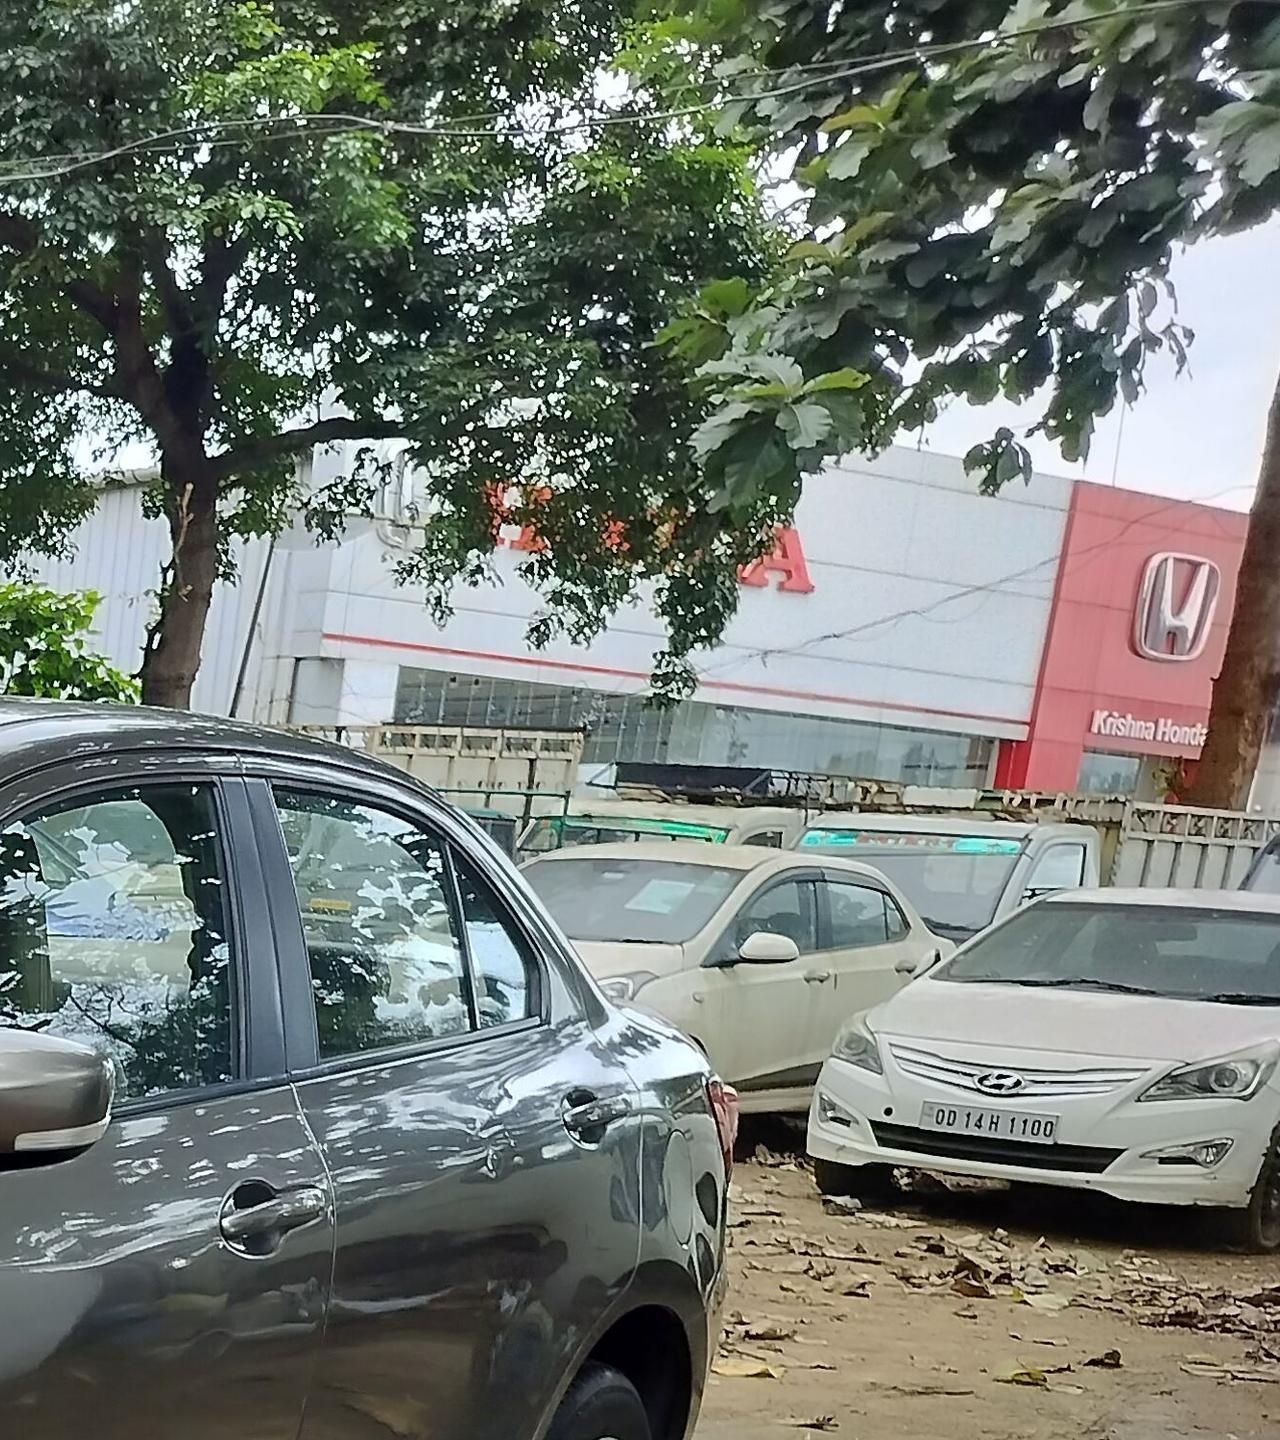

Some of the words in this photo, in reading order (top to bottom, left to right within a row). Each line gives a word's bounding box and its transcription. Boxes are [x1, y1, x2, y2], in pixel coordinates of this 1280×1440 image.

[1090, 709, 1155, 742] Krishna
[935, 1108, 957, 1127] OD
[1009, 1116, 1055, 1138] 1100
